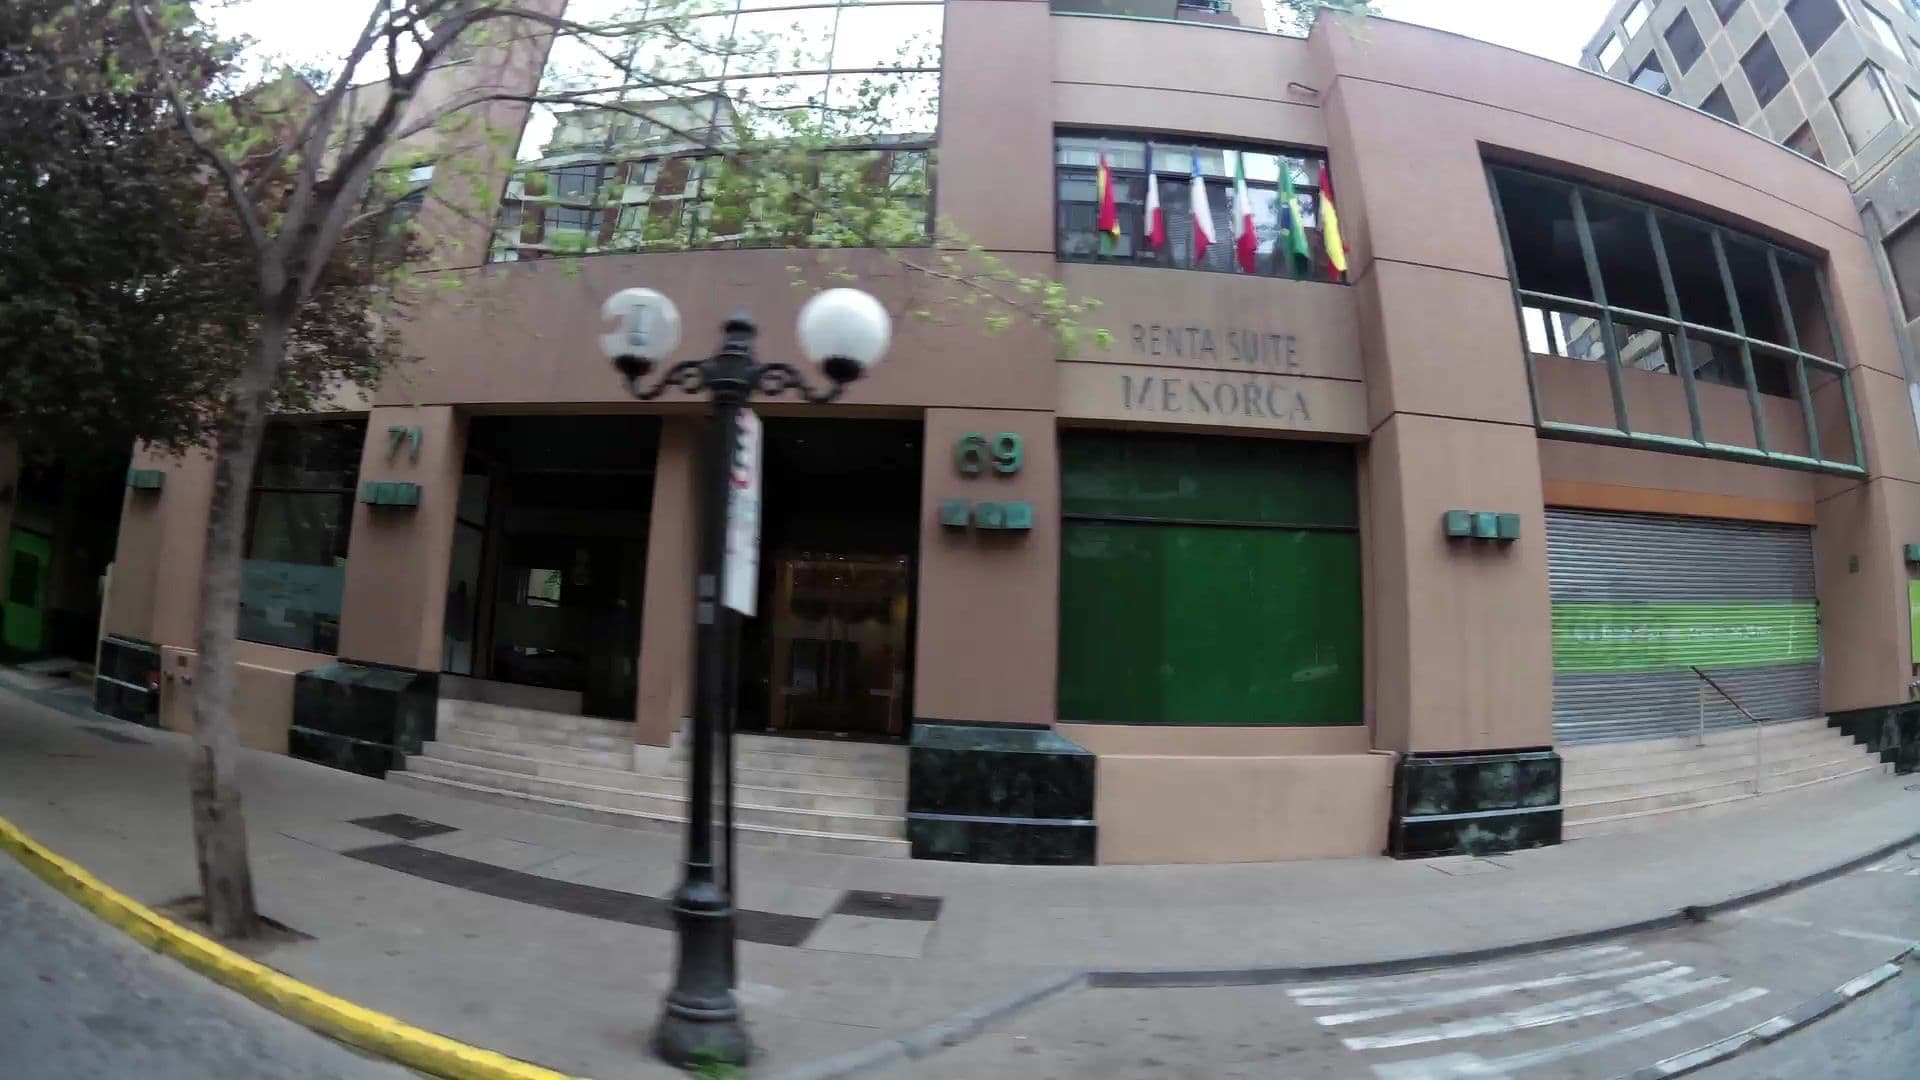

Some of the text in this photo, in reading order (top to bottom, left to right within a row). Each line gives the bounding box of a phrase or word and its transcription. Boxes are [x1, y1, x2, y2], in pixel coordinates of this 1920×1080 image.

[1131, 323, 1299, 368] RENTA SUITE
[1121, 375, 1312, 421] MENORCA
[385, 425, 422, 464] 71
[956, 431, 1024, 474] 69
